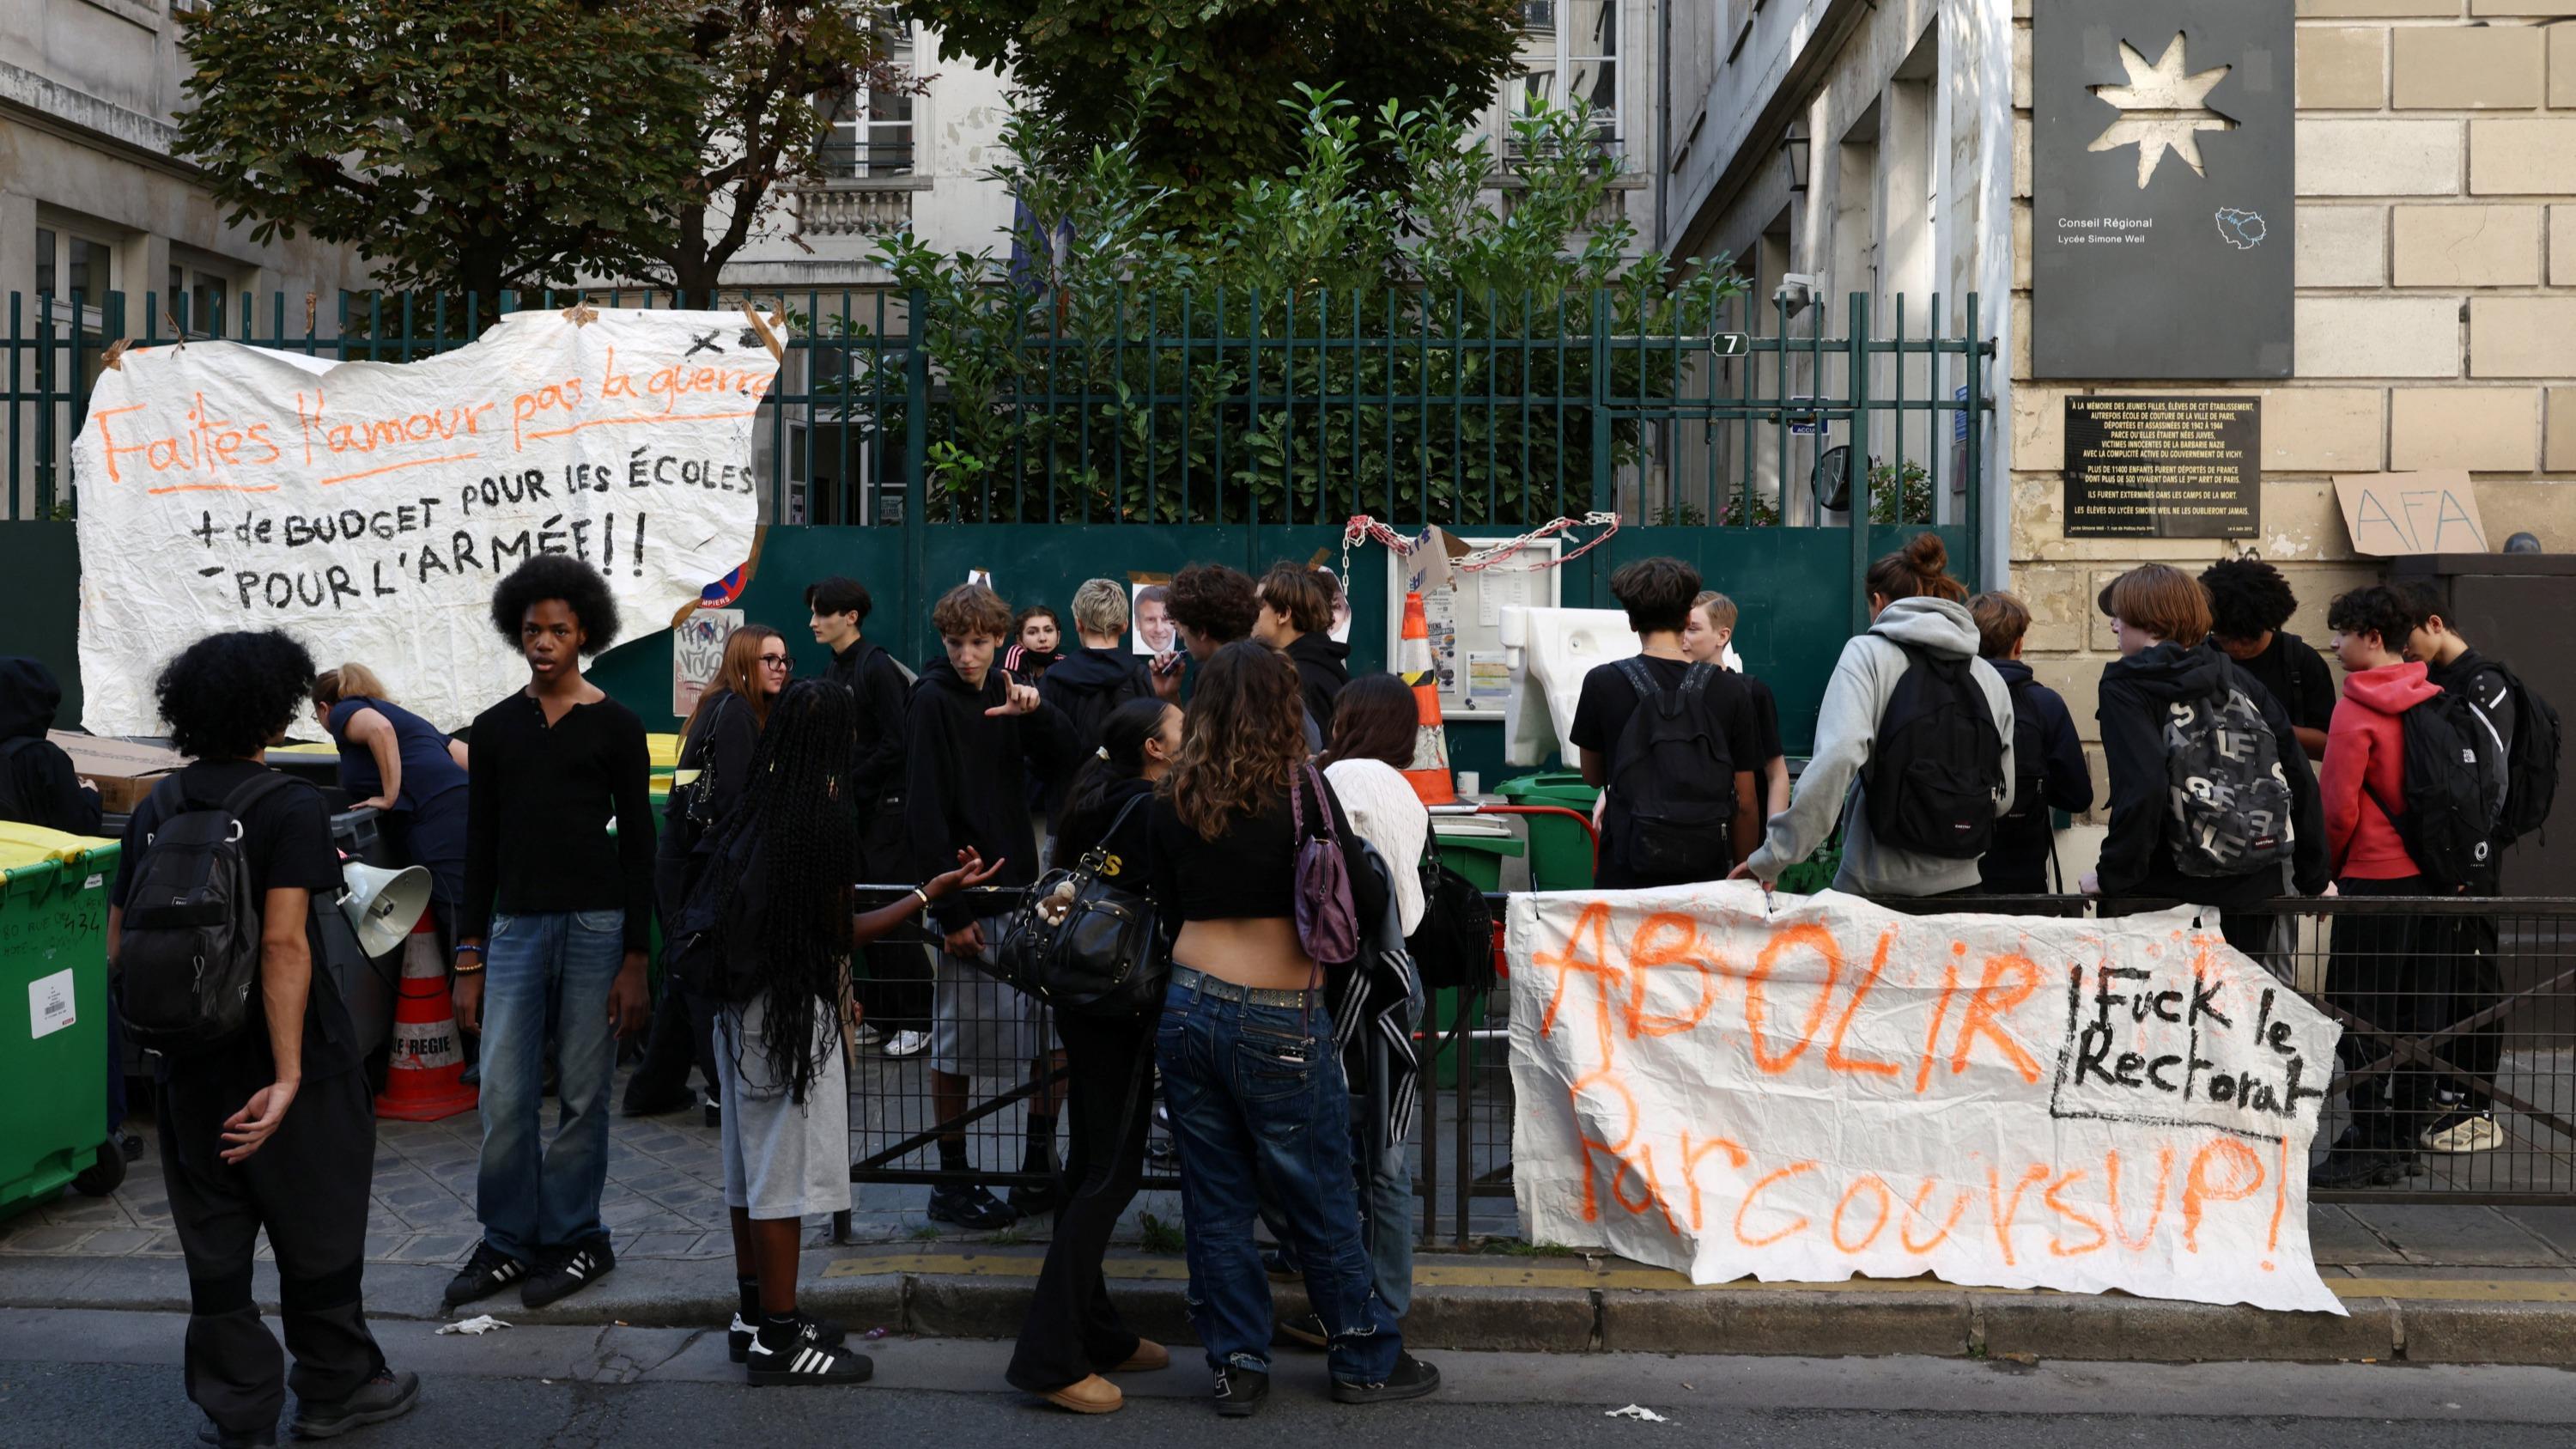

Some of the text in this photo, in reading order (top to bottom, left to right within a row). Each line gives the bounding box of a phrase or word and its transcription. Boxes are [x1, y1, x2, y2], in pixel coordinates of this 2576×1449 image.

[2058, 217, 2153, 229] Conseil Régional
[2058, 234, 2145, 244] Lycée Simone Weil
[1724, 335, 1737, 353] 7
[2072, 400, 2076, 410] À
[2078, 400, 2084, 410] LA
[2087, 400, 2112, 410] MÉMOIRE
[2114, 400, 2124, 410] DES
[2126, 400, 2147, 411] JEUNES
[2148, 401, 2167, 411] FILLES,
[2190, 401, 2196, 411] DE
[2198, 401, 2208, 411] CET
[2210, 401, 2254, 411] ÉTABLISSEMENT,
[93, 391, 281, 483] Faites
[297, 387, 495, 466] l'amour
[513, 376, 583, 452] pas
[647, 362, 778, 414] guerre
[2137, 421, 2144, 429] ET
[2196, 431, 2215, 440] JUIVES,
[2170, 450, 2215, 459] GOUVERNEMENT
[2208, 466, 2215, 474] DE
[2136, 475, 2161, 484] VIVAIENT
[191, 510, 225, 548] +
[234, 510, 271, 548] de
[285, 497, 440, 547] BUDGET
[462, 469, 551, 515] POUR
[629, 443, 754, 495] ÉCOLES
[2120, 490, 2154, 499] EXTERMINÉS
[2075, 506, 2085, 514] LES
[2107, 506, 2116, 514] DU
[2117, 506, 2134, 514] LYCÉE
[2135, 506, 2157, 514] SIMONE
[2192, 507, 2227, 515] OUBLIERONT
[2228, 507, 2249, 515] JAMAIS.
[2358, 489, 2488, 552] AFA
[234, 564, 361, 611] POUR
[702, 596, 731, 606] MPIERS
[2254, 987, 2296, 1056] le
[410, 1036, 450, 1056] REGIE
[2075, 1020, 2324, 1117] Rectorat
